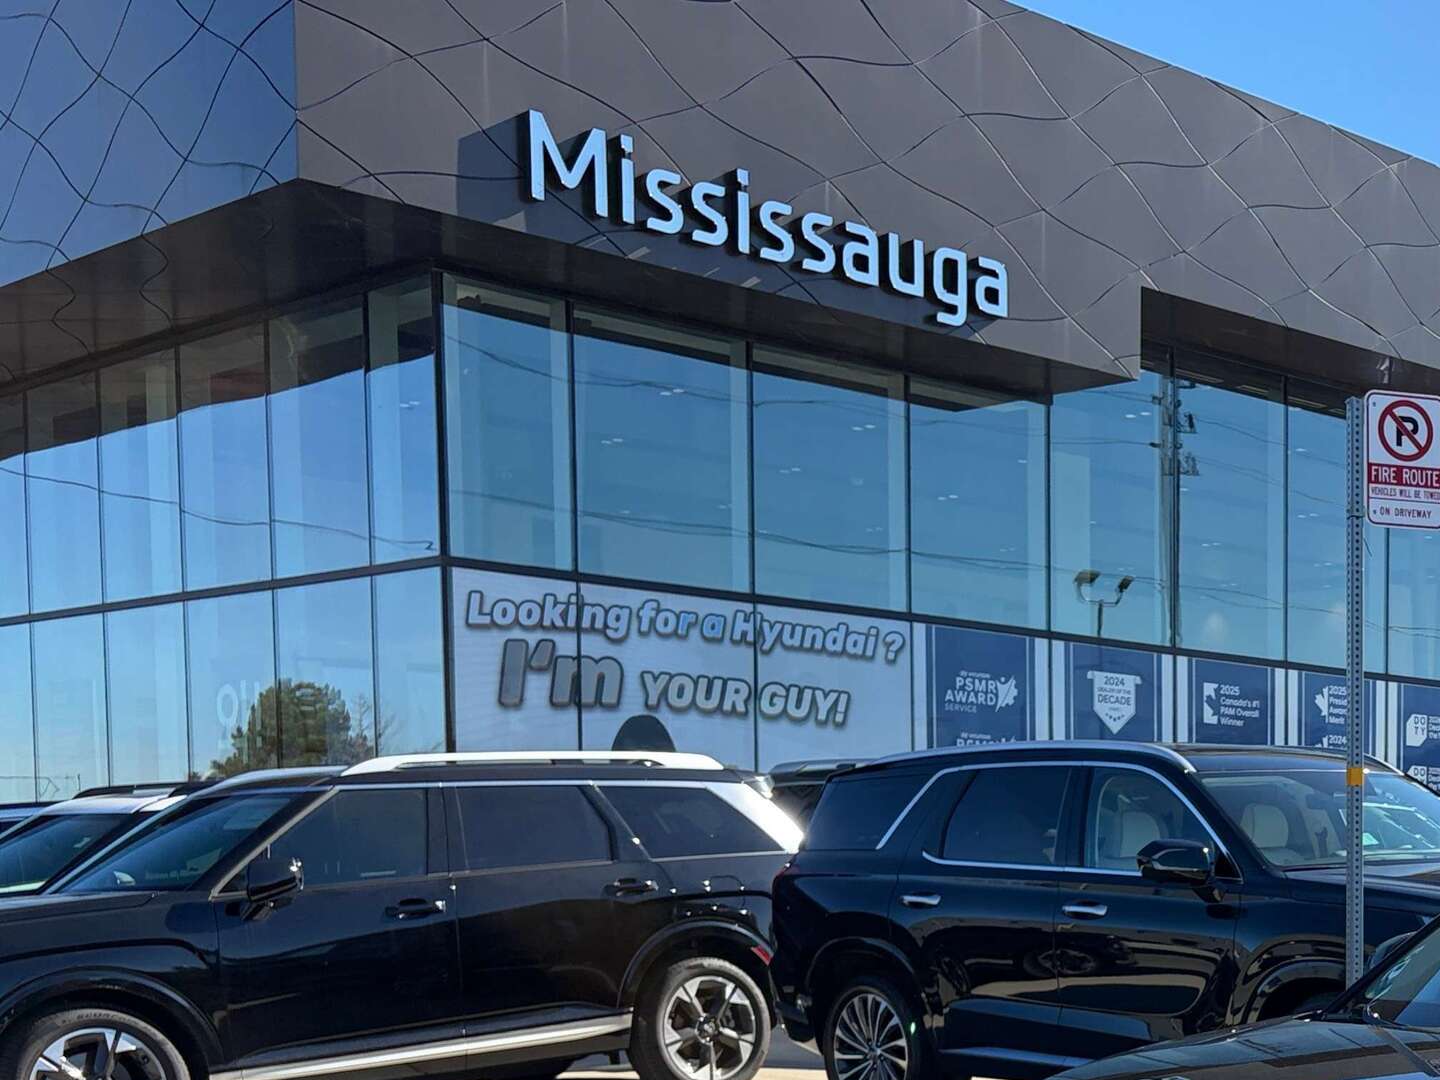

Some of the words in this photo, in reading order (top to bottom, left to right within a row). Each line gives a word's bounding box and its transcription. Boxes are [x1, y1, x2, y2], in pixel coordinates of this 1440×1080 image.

[529, 109, 1008, 326] Mississauga
[1371, 466, 1397, 484] FIRE
[1403, 470, 1440, 487] ROUTE
[1371, 486, 1397, 497] VEHICLES
[1399, 489, 1411, 498] WILL
[1414, 490, 1421, 499] BE
[1423, 491, 1440, 501] TOWED
[1380, 506, 1390, 515] ON
[1394, 508, 1432, 519] DRIVEWAY
[466, 590, 632, 642] Looking
[637, 598, 697, 638] for
[700, 614, 727, 641] a
[498, 638, 624, 709] I'm
[641, 670, 752, 715] YOUR
[757, 682, 852, 728] GUY!
[956, 677, 996, 693] PSMR
[1104, 675, 1125, 687] 2024
[945, 689, 996, 705] AWARD
[1097, 694, 1131, 706] DECADE
[945, 703, 977, 713] SERVICE
